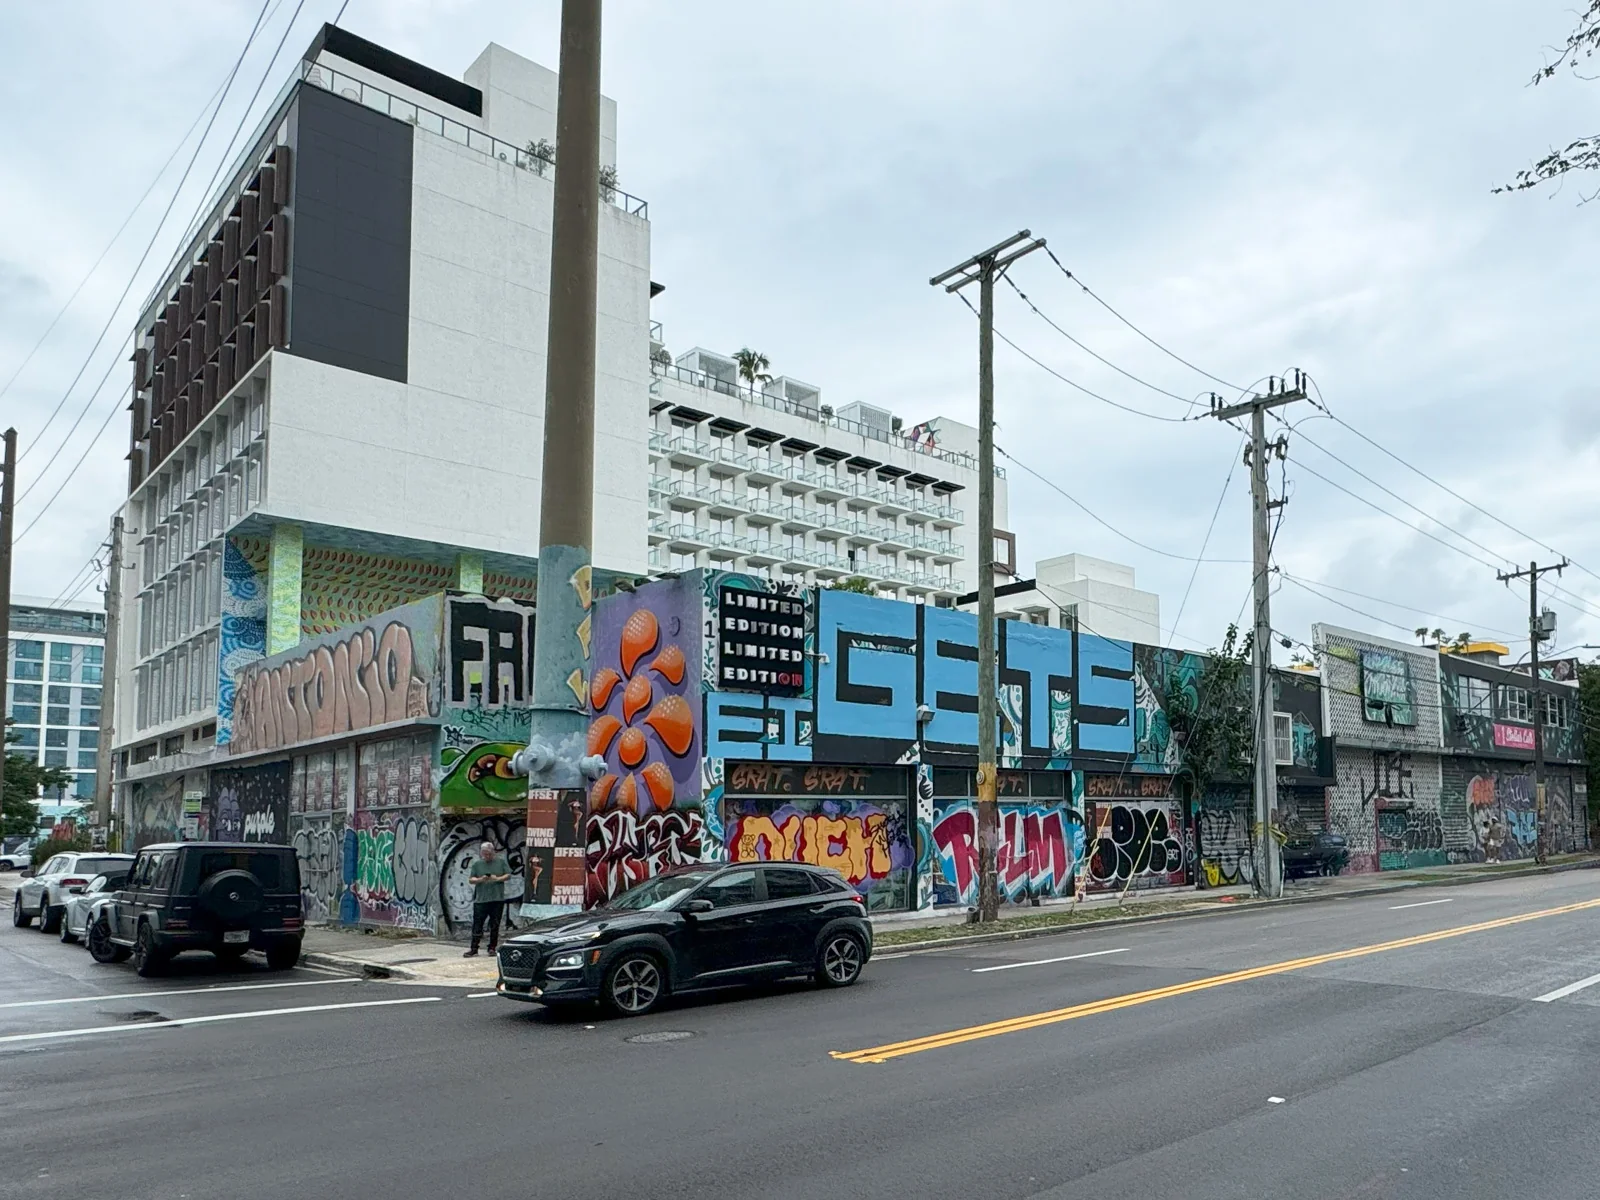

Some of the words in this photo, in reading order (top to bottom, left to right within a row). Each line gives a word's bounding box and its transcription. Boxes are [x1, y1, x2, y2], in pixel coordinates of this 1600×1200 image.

[725, 592, 803, 615] LIMITED
[725, 617, 803, 639] EDITION
[724, 642, 803, 662] LIMITED
[723, 667, 803, 686] EDITION
[554, 847, 585, 857] OFFSE
